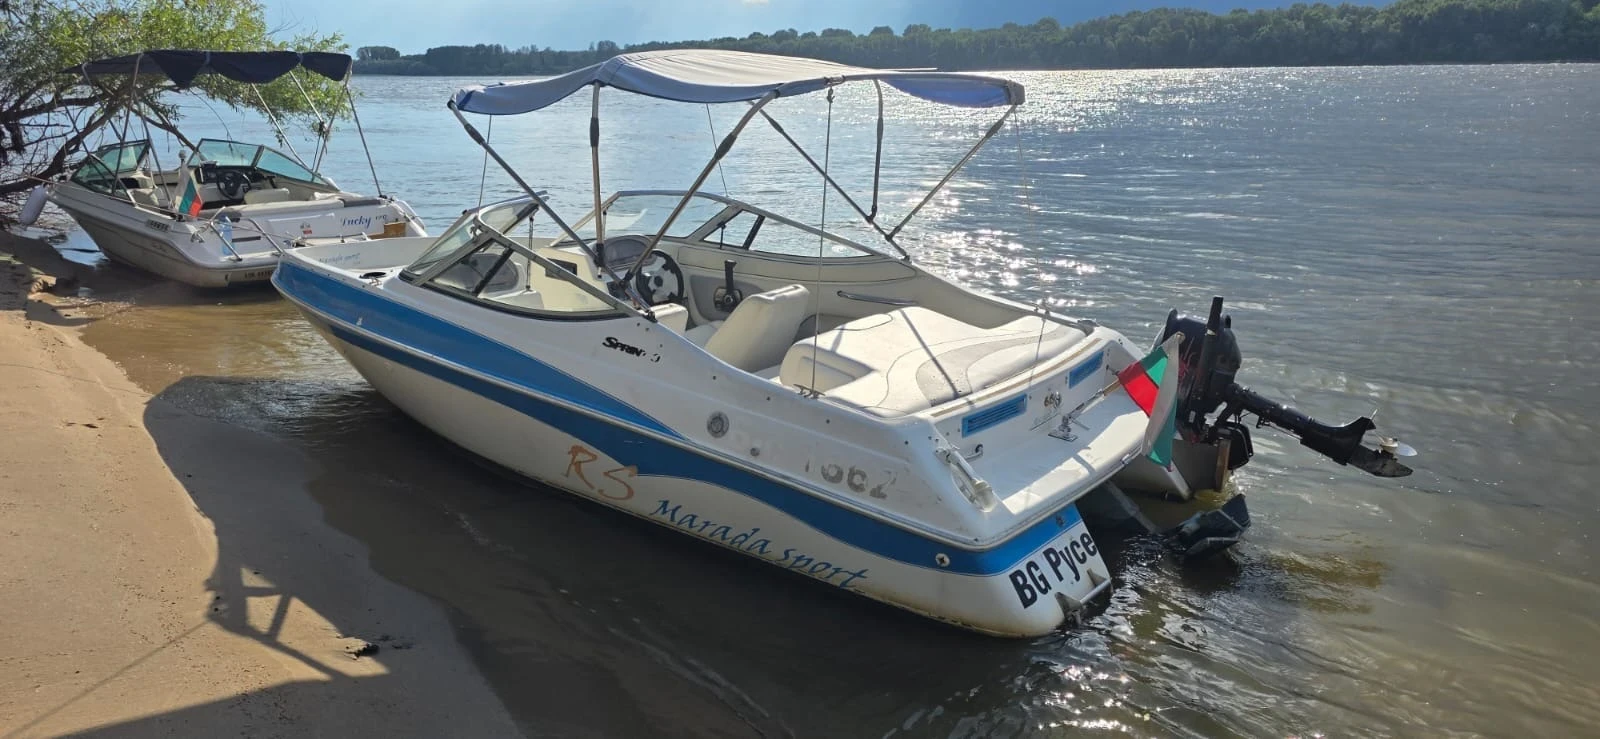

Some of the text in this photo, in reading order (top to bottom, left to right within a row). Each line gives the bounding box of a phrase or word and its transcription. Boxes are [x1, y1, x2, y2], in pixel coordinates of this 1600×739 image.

[563, 444, 638, 500] RS
[650, 500, 869, 588] Marada sport
[1009, 560, 1052, 609] BG
